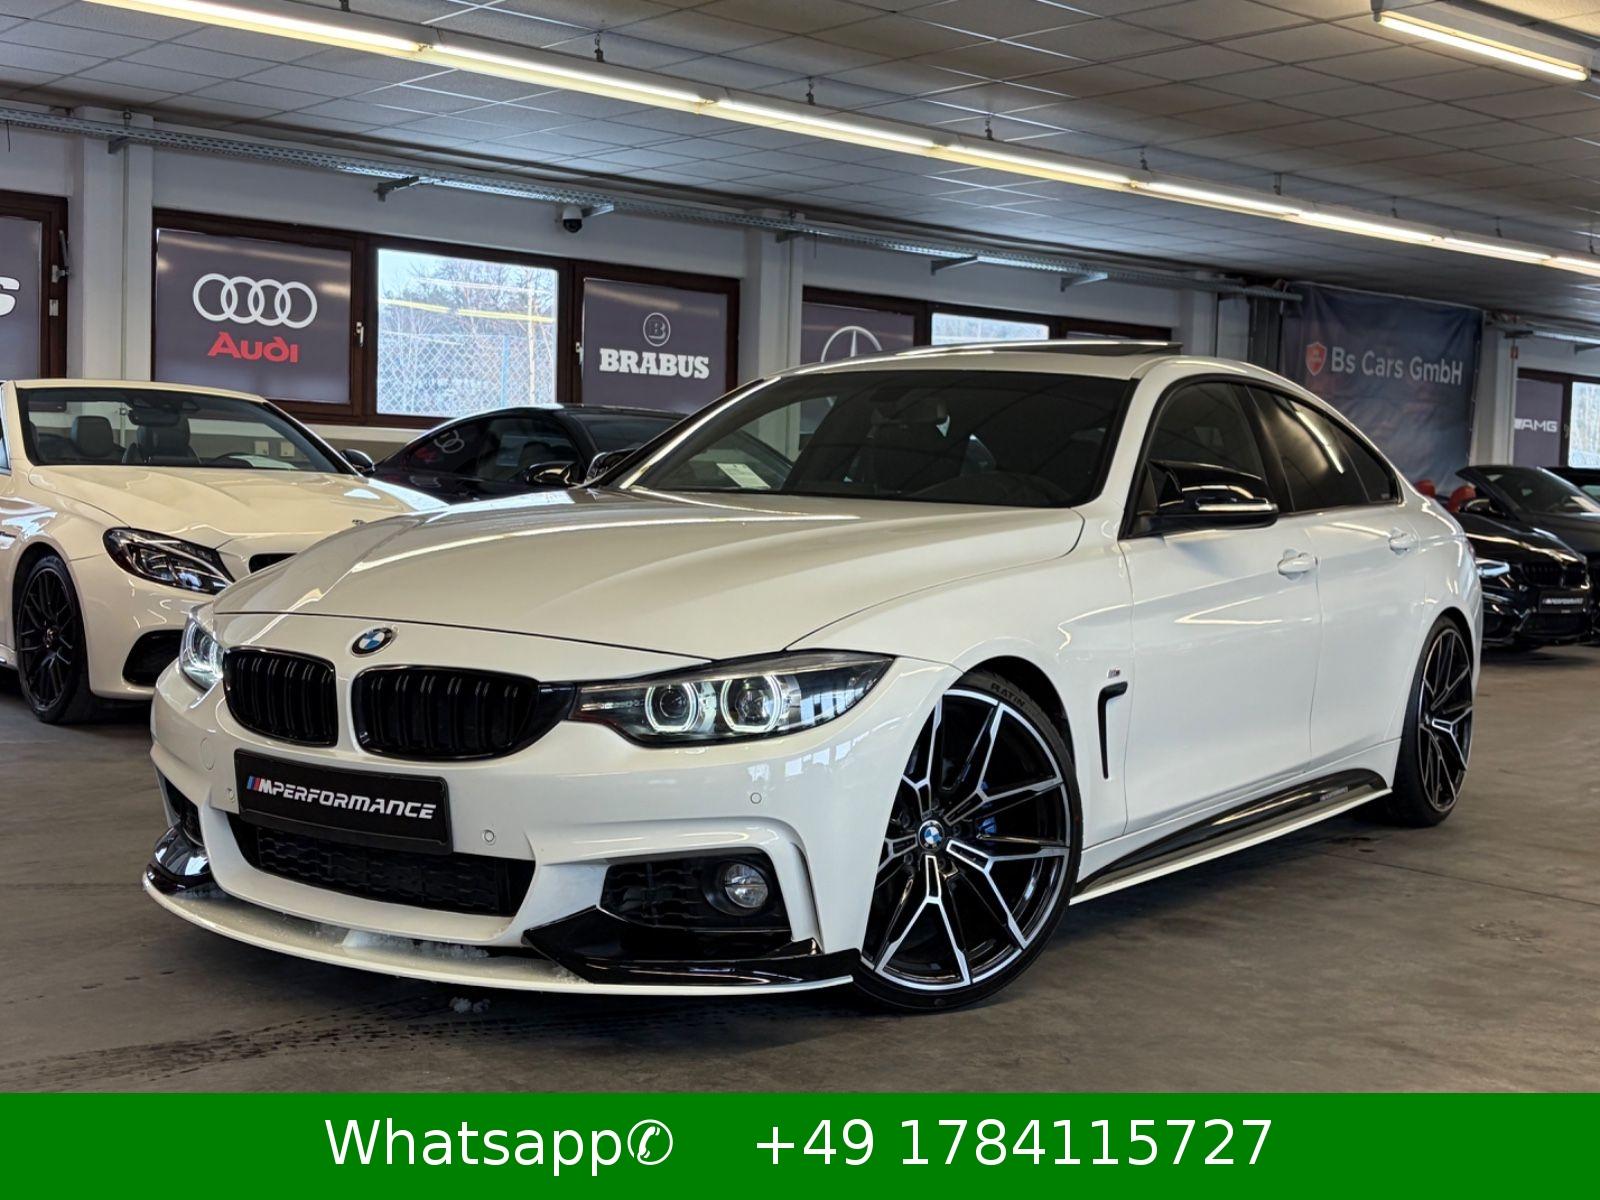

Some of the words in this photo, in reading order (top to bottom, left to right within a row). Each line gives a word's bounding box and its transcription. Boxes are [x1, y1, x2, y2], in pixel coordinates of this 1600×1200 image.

[208, 331, 298, 363] Audi
[599, 347, 710, 380] BRABUS
[1331, 346, 1356, 374] Bs
[1361, 350, 1404, 379] Cars
[1409, 356, 1463, 386] GmbH
[1521, 418, 1558, 433] AMG
